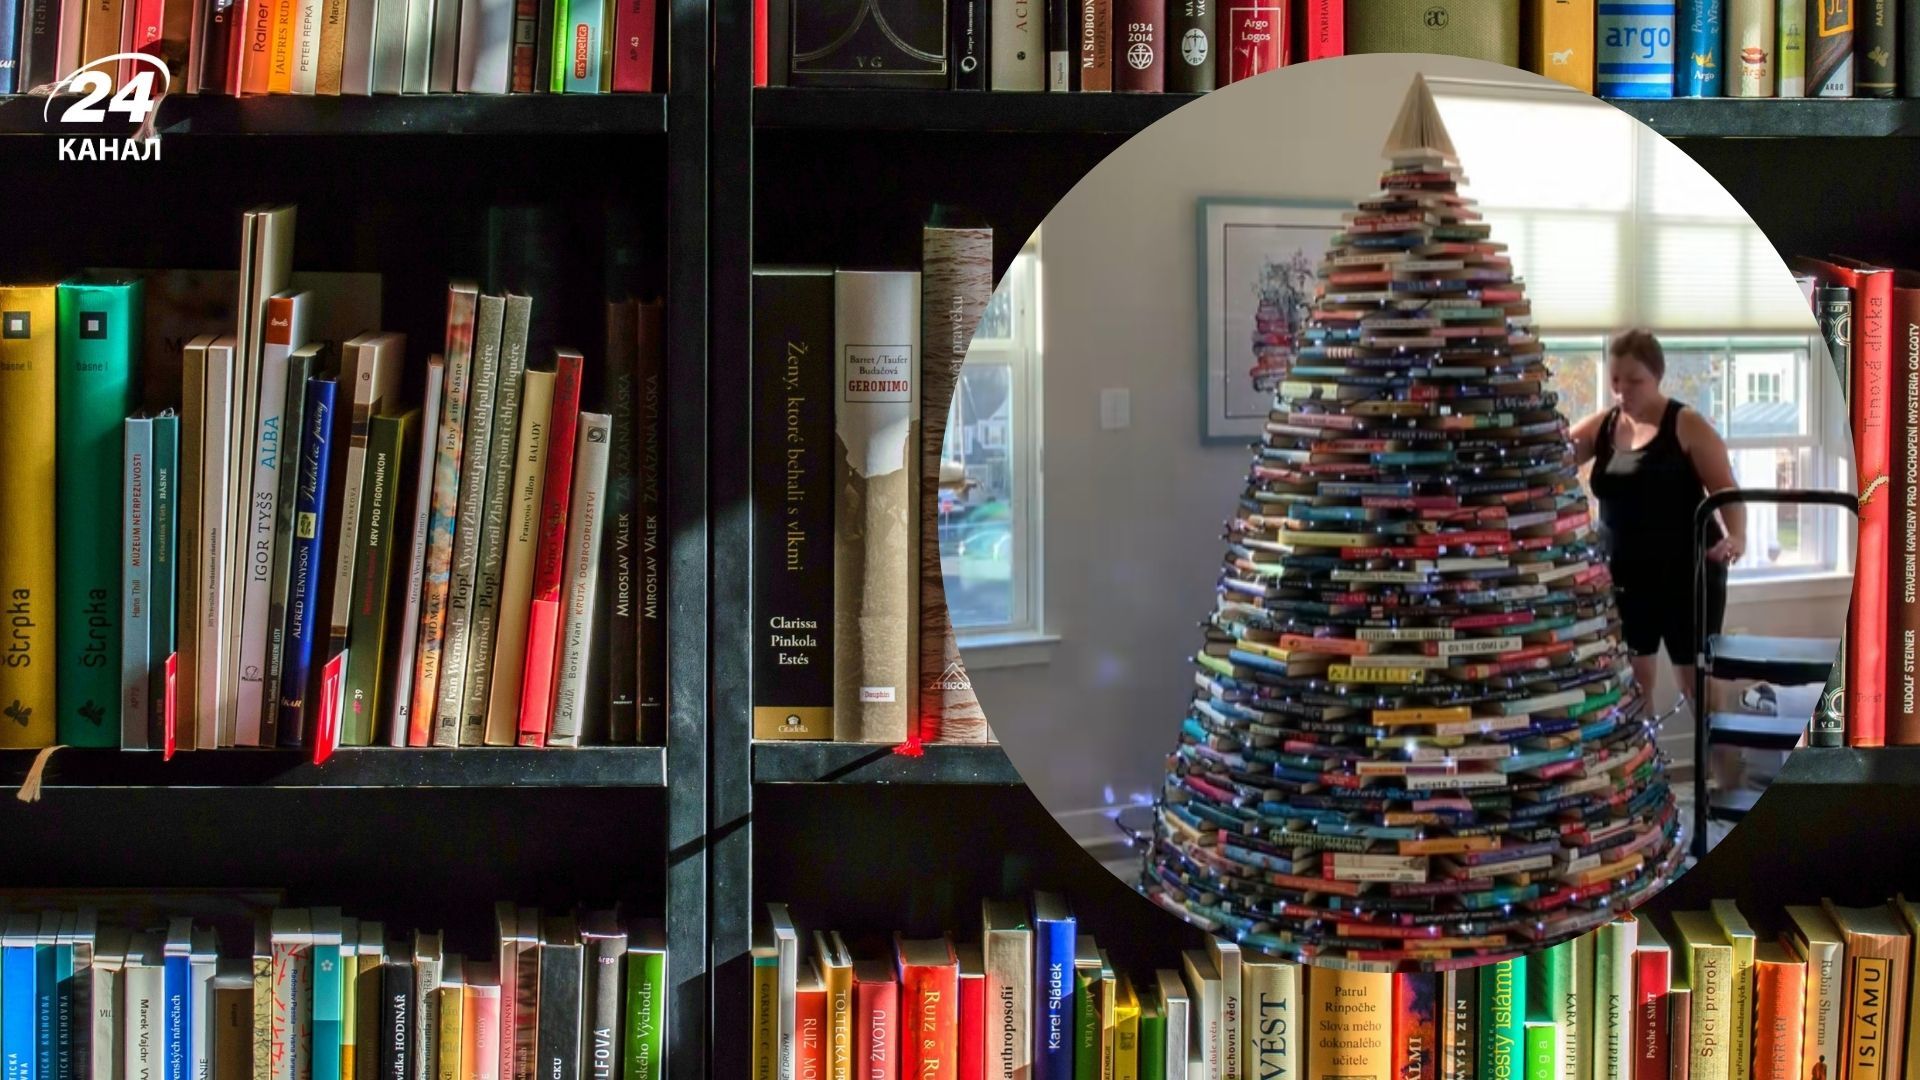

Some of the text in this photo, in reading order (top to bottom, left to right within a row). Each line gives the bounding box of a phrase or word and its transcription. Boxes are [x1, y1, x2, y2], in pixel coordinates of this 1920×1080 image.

[252, 3, 269, 53] Rainer
[299, 5, 315, 72] PETER REPKA
[631, 36, 640, 48] 43
[1127, 22, 1154, 32] 1934
[1127, 32, 1154, 42] 2014
[1241, 31, 1271, 43] Logos
[1244, 18, 1269, 30] Argo
[1606, 26, 1671, 59] argo
[274, 27, 289, 75] JAUFRES
[1083, 53, 1095, 69] M.
[1694, 71, 1715, 83] Argo
[1825, 83, 1844, 91] ARGO
[948, 295, 967, 354] pravěku
[451, 362, 464, 395] básne
[859, 366, 899, 375] Budačová
[1861, 296, 1884, 435] Trnová dívka
[848, 380, 909, 392] GERONIMO
[474, 388, 492, 427] chlpal
[500, 388, 517, 426] chlpal
[445, 426, 459, 451] Izby
[473, 434, 489, 470] pšunt
[497, 433, 512, 469] pšunt
[783, 340, 806, 571] Ženy, ktoré behali vlkmi
[372, 451, 387, 508] FIGOVNÍKOM
[518, 420, 542, 543] François Villon BALADY
[1904, 322, 1920, 604] STAVEBNÍ KAMENY PRO POCHOPENÍ MYSTERIA GOLGOTY
[158, 468, 168, 500] BÁSNE
[253, 415, 280, 583] IGOR TYŠŠ ALBA
[131, 453, 143, 619] Hans Thill NETRPEZLIVOSTI
[370, 508, 381, 527] POD
[578, 490, 597, 579] DOBRODRUŽSTVÍ
[615, 513, 630, 551] VÁLEK
[642, 515, 658, 553] VÁLEK
[368, 528, 380, 547] KRV
[458, 527, 476, 569] Vyvrtil
[485, 526, 501, 568] Vyvrtil
[341, 554, 350, 577] HOST
[291, 545, 309, 638] ALFRED TENNYSON
[410, 576, 421, 604] Marcela
[452, 572, 472, 610] Plop!
[478, 571, 499, 609] Plop!
[616, 555, 631, 617] MIROSLAV
[643, 557, 658, 619] MIROSLAV
[0, 587, 36, 668] Štrpka
[76, 587, 113, 668] Štrpka
[427, 592, 441, 643] VIDMAR
[570, 622, 582, 647] Vian
[769, 615, 818, 630] Clarissa
[446, 617, 465, 675] Wernisch
[473, 616, 491, 674] Wernisch
[770, 633, 817, 648] Pinkola
[777, 651, 810, 666] Estés
[424, 647, 436, 679] MAJA
[566, 651, 580, 680] Boris
[1902, 629, 1915, 714] RUDOLF STEINER
[353, 688, 364, 700] 39
[444, 676, 458, 704] Ivan
[470, 675, 485, 703] Ivan
[1738, 959, 1748, 984] tradic
[636, 982, 654, 1039] Východu
[1048, 962, 1063, 1049] Karel Sládek
[1334, 986, 1368, 997] Patrul
[1491, 959, 1513, 1029] islámu
[1566, 992, 1577, 1028] KARA
[1608, 993, 1620, 1028] KARA
[1647, 991, 1657, 1020] SMRT
[1700, 959, 1719, 1058] Spící prorok
[1817, 959, 1833, 1046] Robin Sharma
[41, 994, 51, 1045] KNIHOVNA
[59, 994, 69, 1045] KNIHOVNA
[138, 999, 150, 1063] Marek Vajchr
[168, 994, 181, 1039] nárečiach
[393, 993, 407, 1051] HODINÁŘ
[504, 995, 513, 1059] NA SLOVENSKU
[802, 1017, 817, 1049] RUIZ
[1000, 984, 1017, 1079] anthroposofií
[1319, 1019, 1382, 1032] Slova mého
[1456, 999, 1467, 1031] ZEN
[1857, 967, 1881, 1067] ISLÁMU
[869, 1009, 887, 1062] ŽIVOTU
[1084, 1021, 1096, 1049] VERA
[1209, 1021, 1217, 1067] duše světa
[1226, 995, 1238, 1080] duchovní vědy
[1319, 1037, 1382, 1049] dokonalého
[1332, 1054, 1369, 1066] učitele
